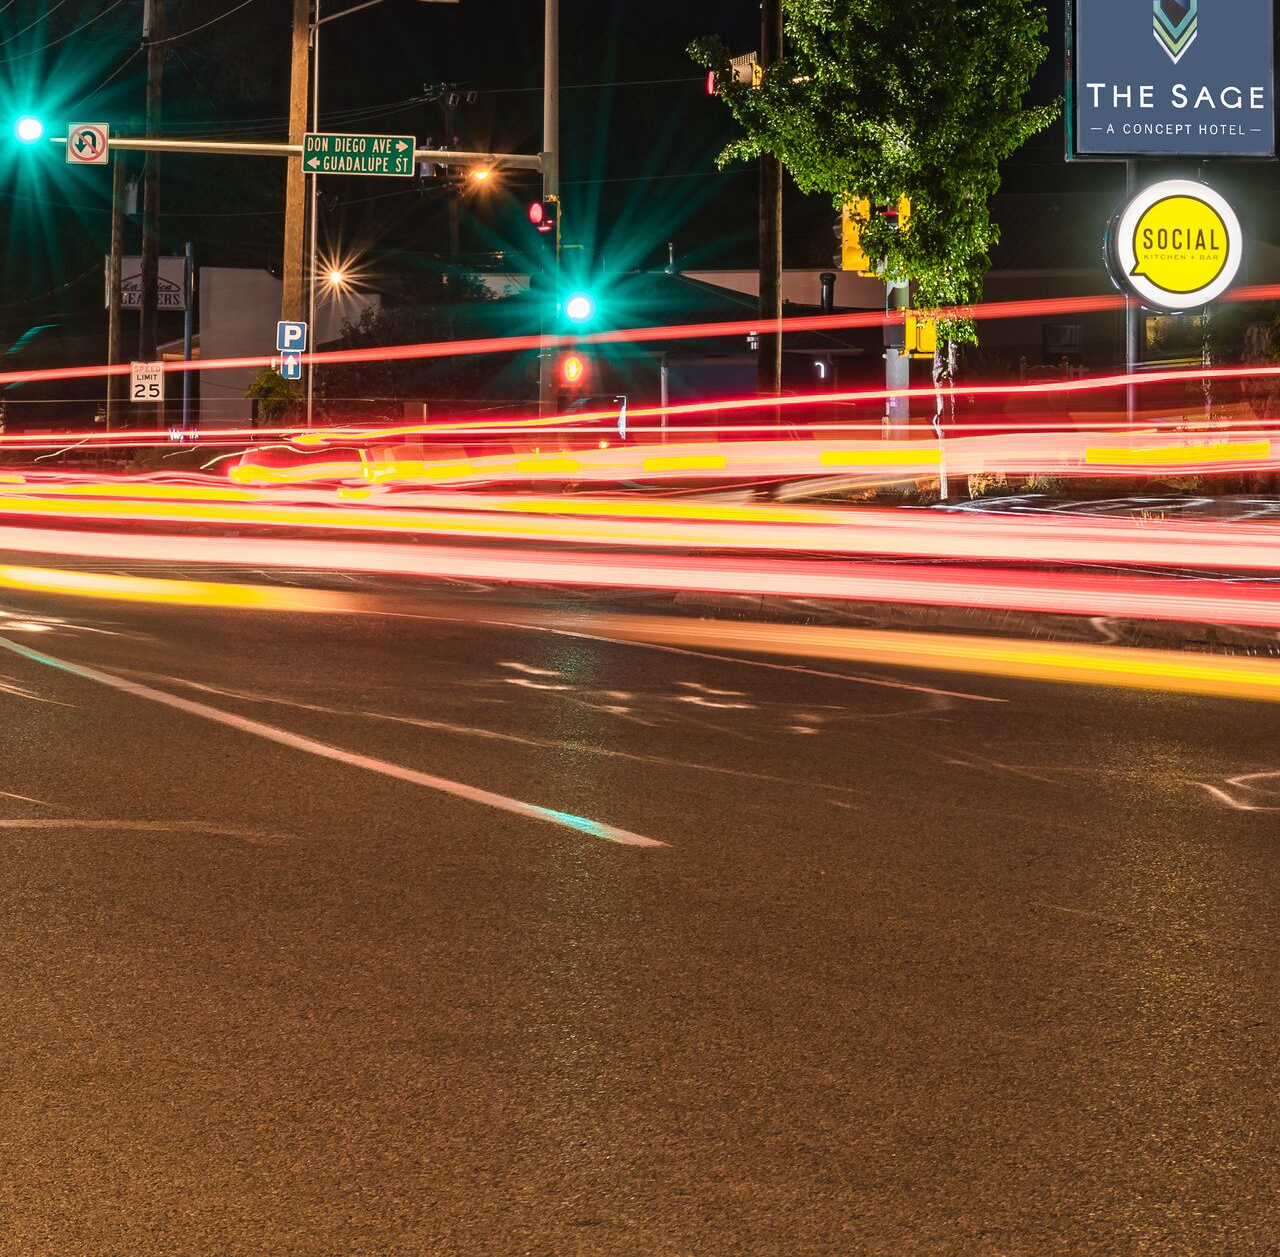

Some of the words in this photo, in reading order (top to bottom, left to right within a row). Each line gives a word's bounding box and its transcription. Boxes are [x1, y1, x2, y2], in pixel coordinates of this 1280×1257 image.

[1086, 83, 1154, 108] THE
[1171, 83, 1264, 109] SAGE
[1106, 123, 1115, 134] A
[1123, 123, 1192, 135] CONCEPT
[1199, 124, 1245, 136] HOTEL
[307, 137, 329, 152] DON
[335, 137, 366, 153] DIEGO
[372, 138, 392, 154] AVE
[323, 155, 389, 172] GUADALUPE
[395, 157, 409, 173] ST
[1143, 228, 1219, 250] SOCIAL
[284, 325, 302, 348] P
[134, 365, 161, 373] SPEED
[134, 384, 160, 398] 25
